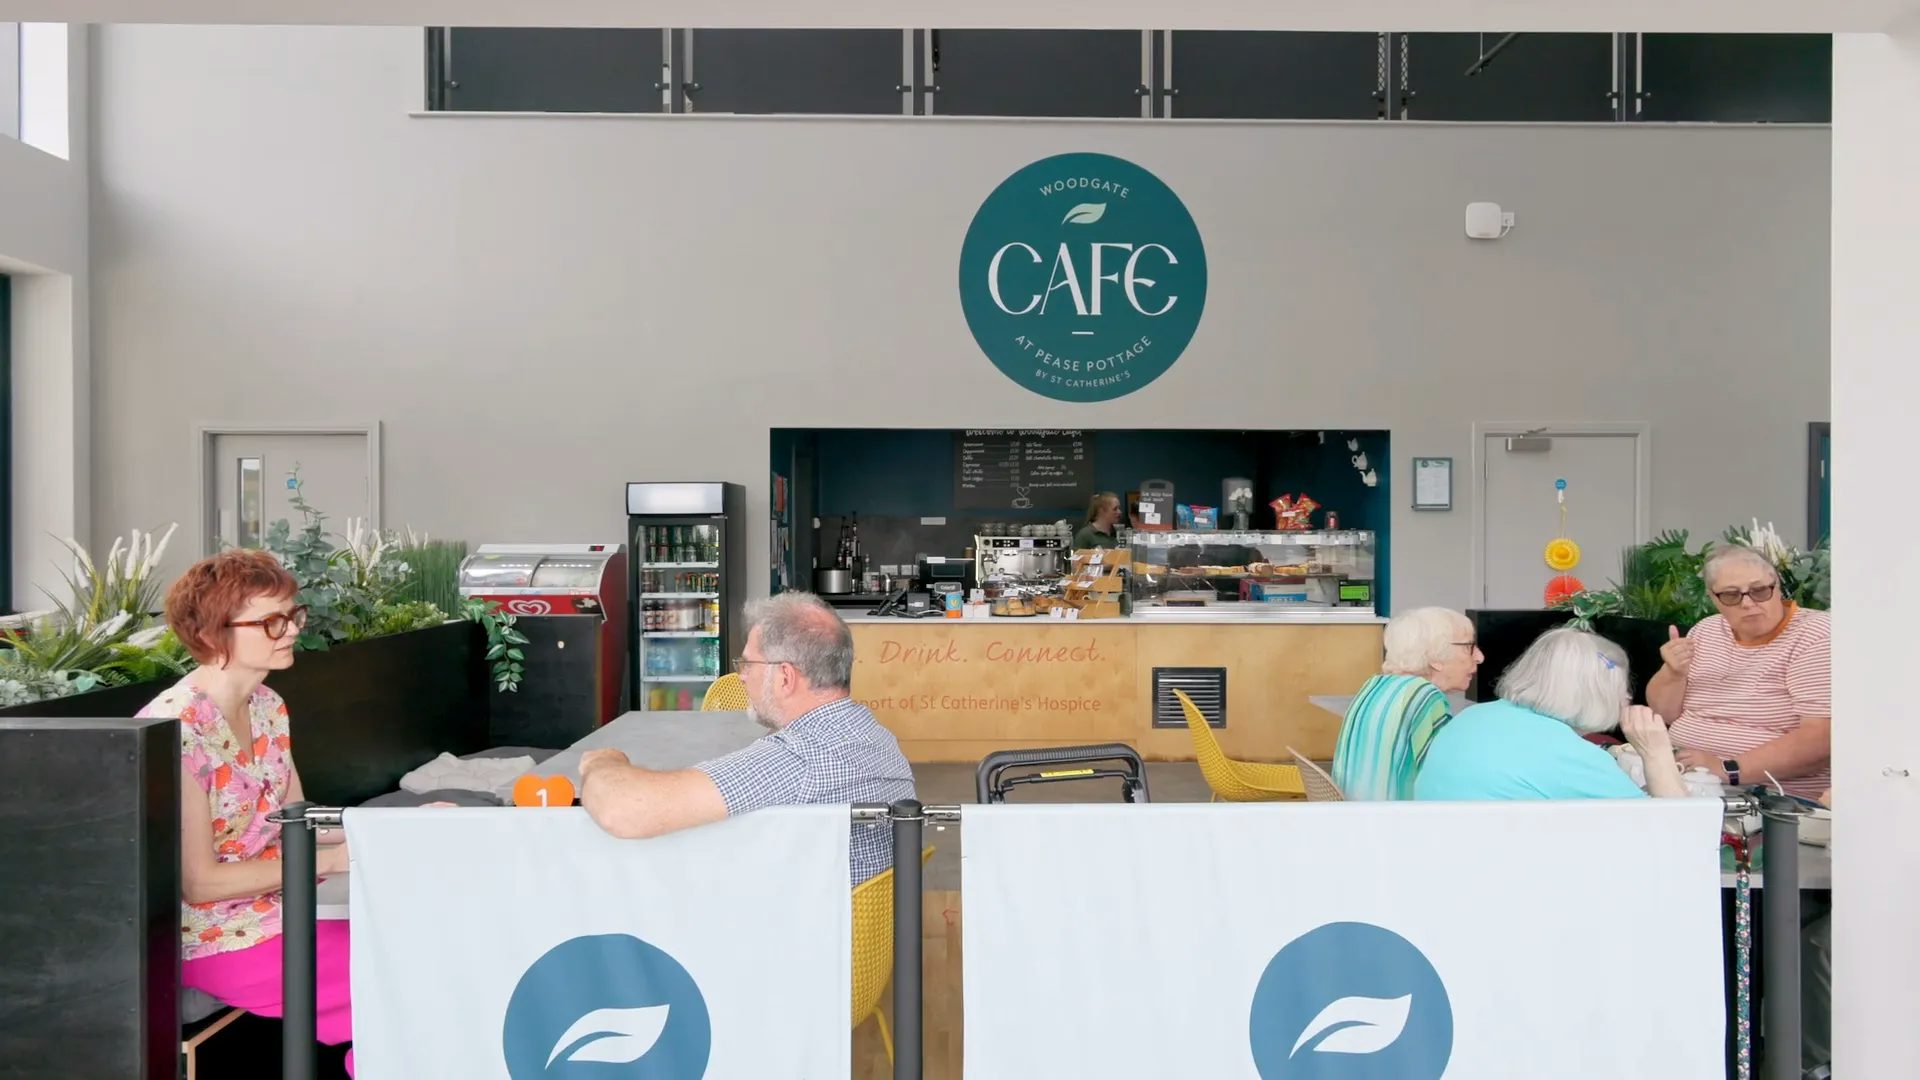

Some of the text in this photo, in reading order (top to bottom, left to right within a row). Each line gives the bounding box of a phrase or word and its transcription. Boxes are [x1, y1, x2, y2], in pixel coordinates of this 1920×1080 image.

[1039, 177, 1129, 199] WOODGATE
[988, 242, 1179, 316] CAFE
[1014, 334, 1152, 372] AT PEASE POTTAGE
[1035, 369, 1132, 388] BY ST CATHERINE'S
[879, 638, 1107, 665] Drink. Connect.
[899, 695, 919, 710] of
[921, 695, 937, 710] St
[941, 695, 1033, 711] Catherine's
[1038, 696, 1102, 714] Hospice
[536, 788, 548, 807] 1
